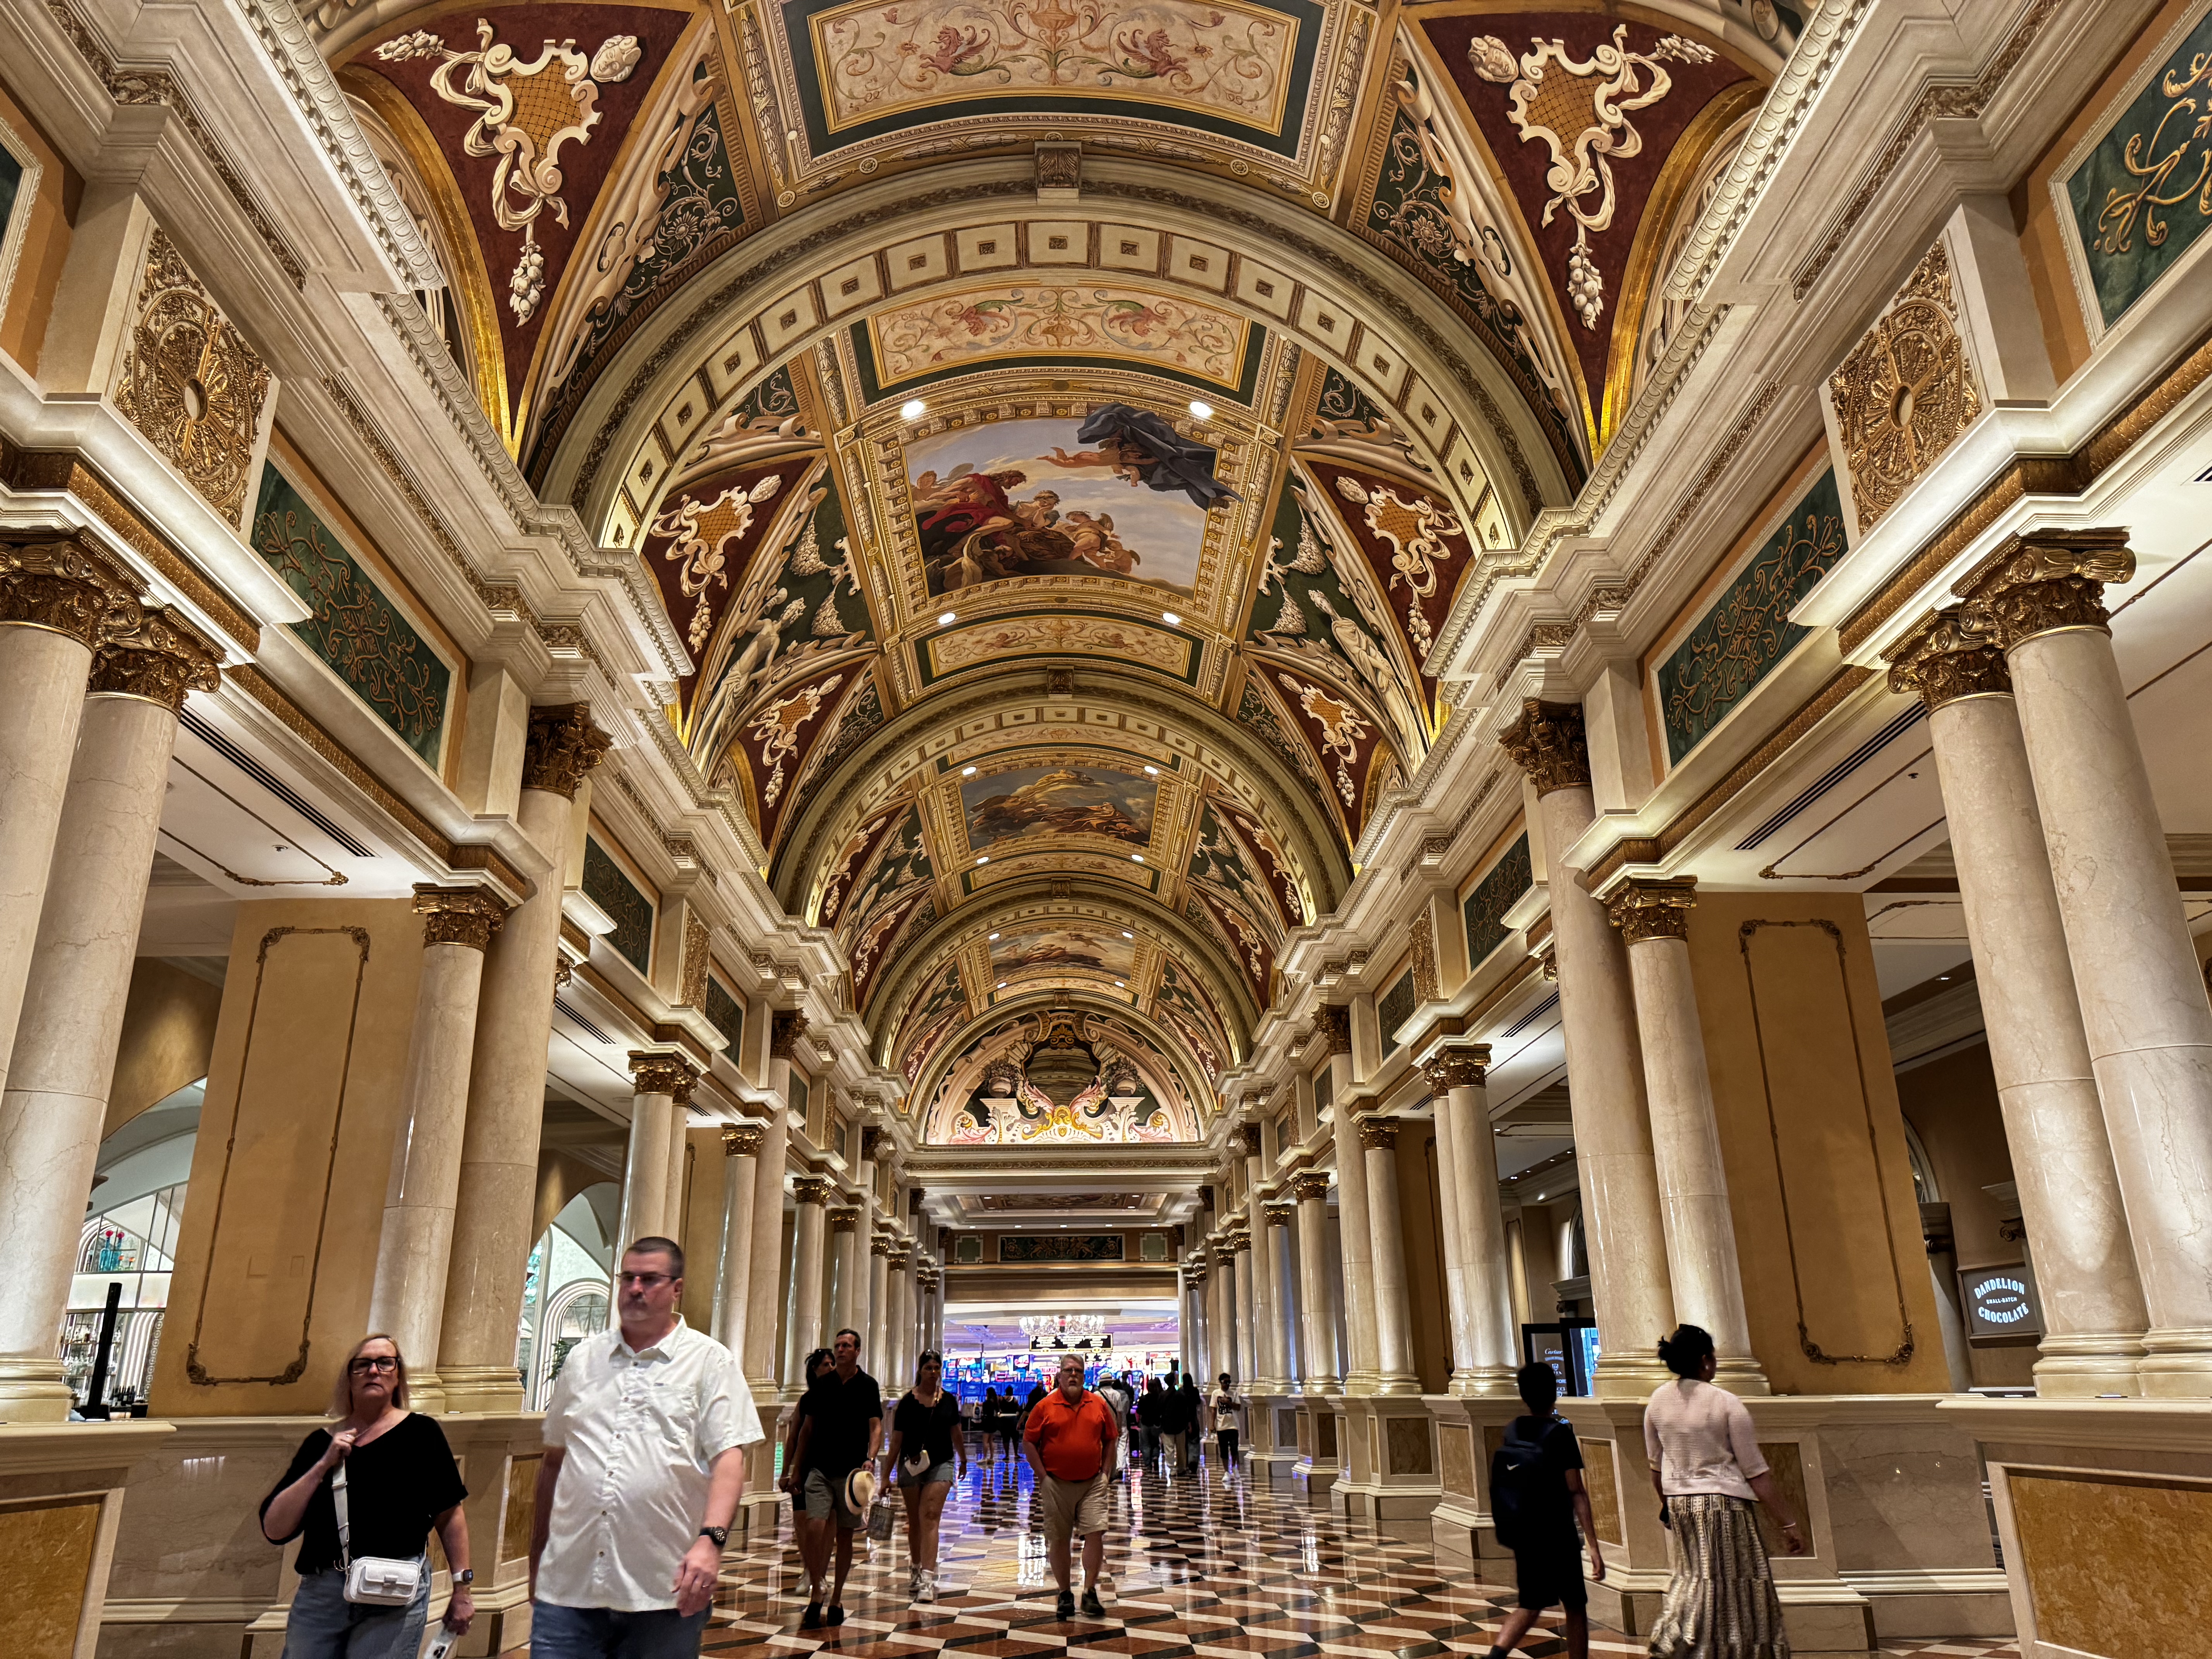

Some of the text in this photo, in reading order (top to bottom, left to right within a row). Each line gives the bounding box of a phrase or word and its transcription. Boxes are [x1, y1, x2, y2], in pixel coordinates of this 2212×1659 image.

[1974, 1278, 2025, 1299] DANDELION
[1986, 1297, 2018, 1305] SMALL-BATCH
[1978, 1302, 2029, 1323] CHOCOLATE
